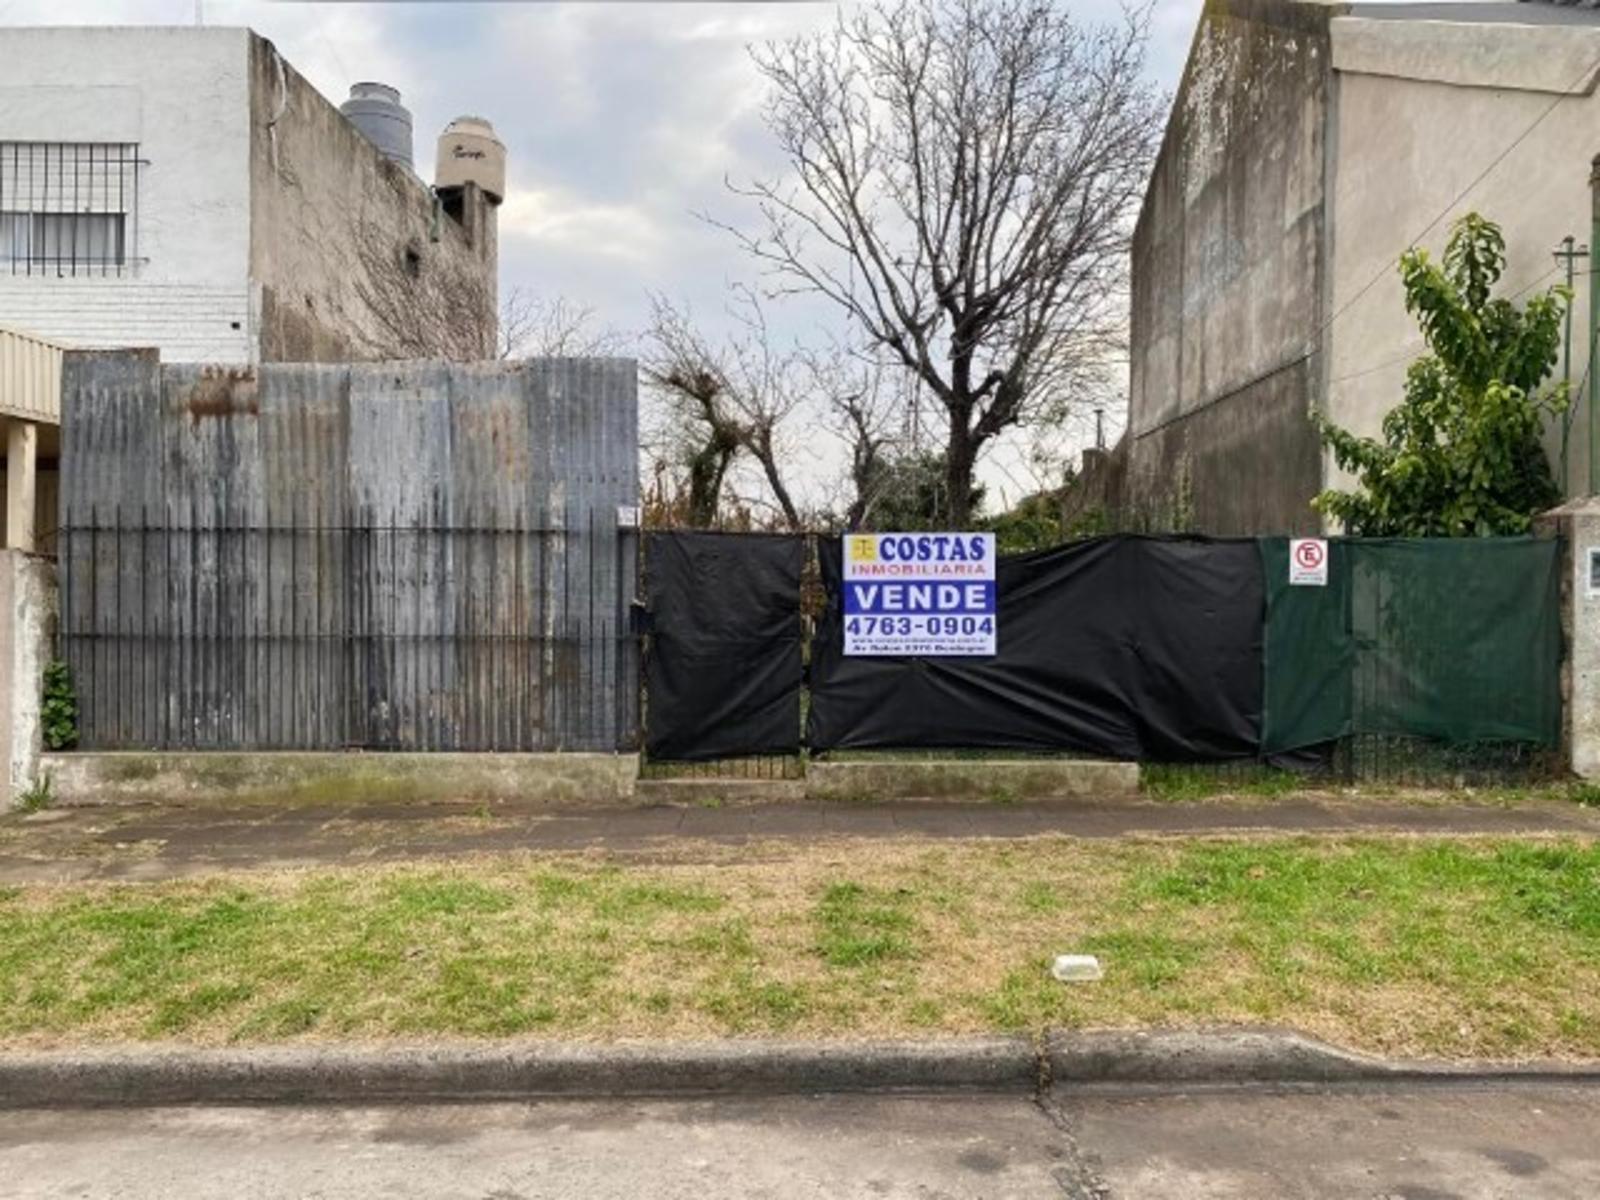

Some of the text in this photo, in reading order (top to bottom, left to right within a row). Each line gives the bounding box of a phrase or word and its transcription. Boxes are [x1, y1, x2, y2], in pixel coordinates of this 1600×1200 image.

[879, 536, 986, 561] COSTAS
[852, 564, 987, 576] INMOBILIARIA
[854, 584, 986, 610] VENDE
[847, 616, 993, 636] 4763-0904
